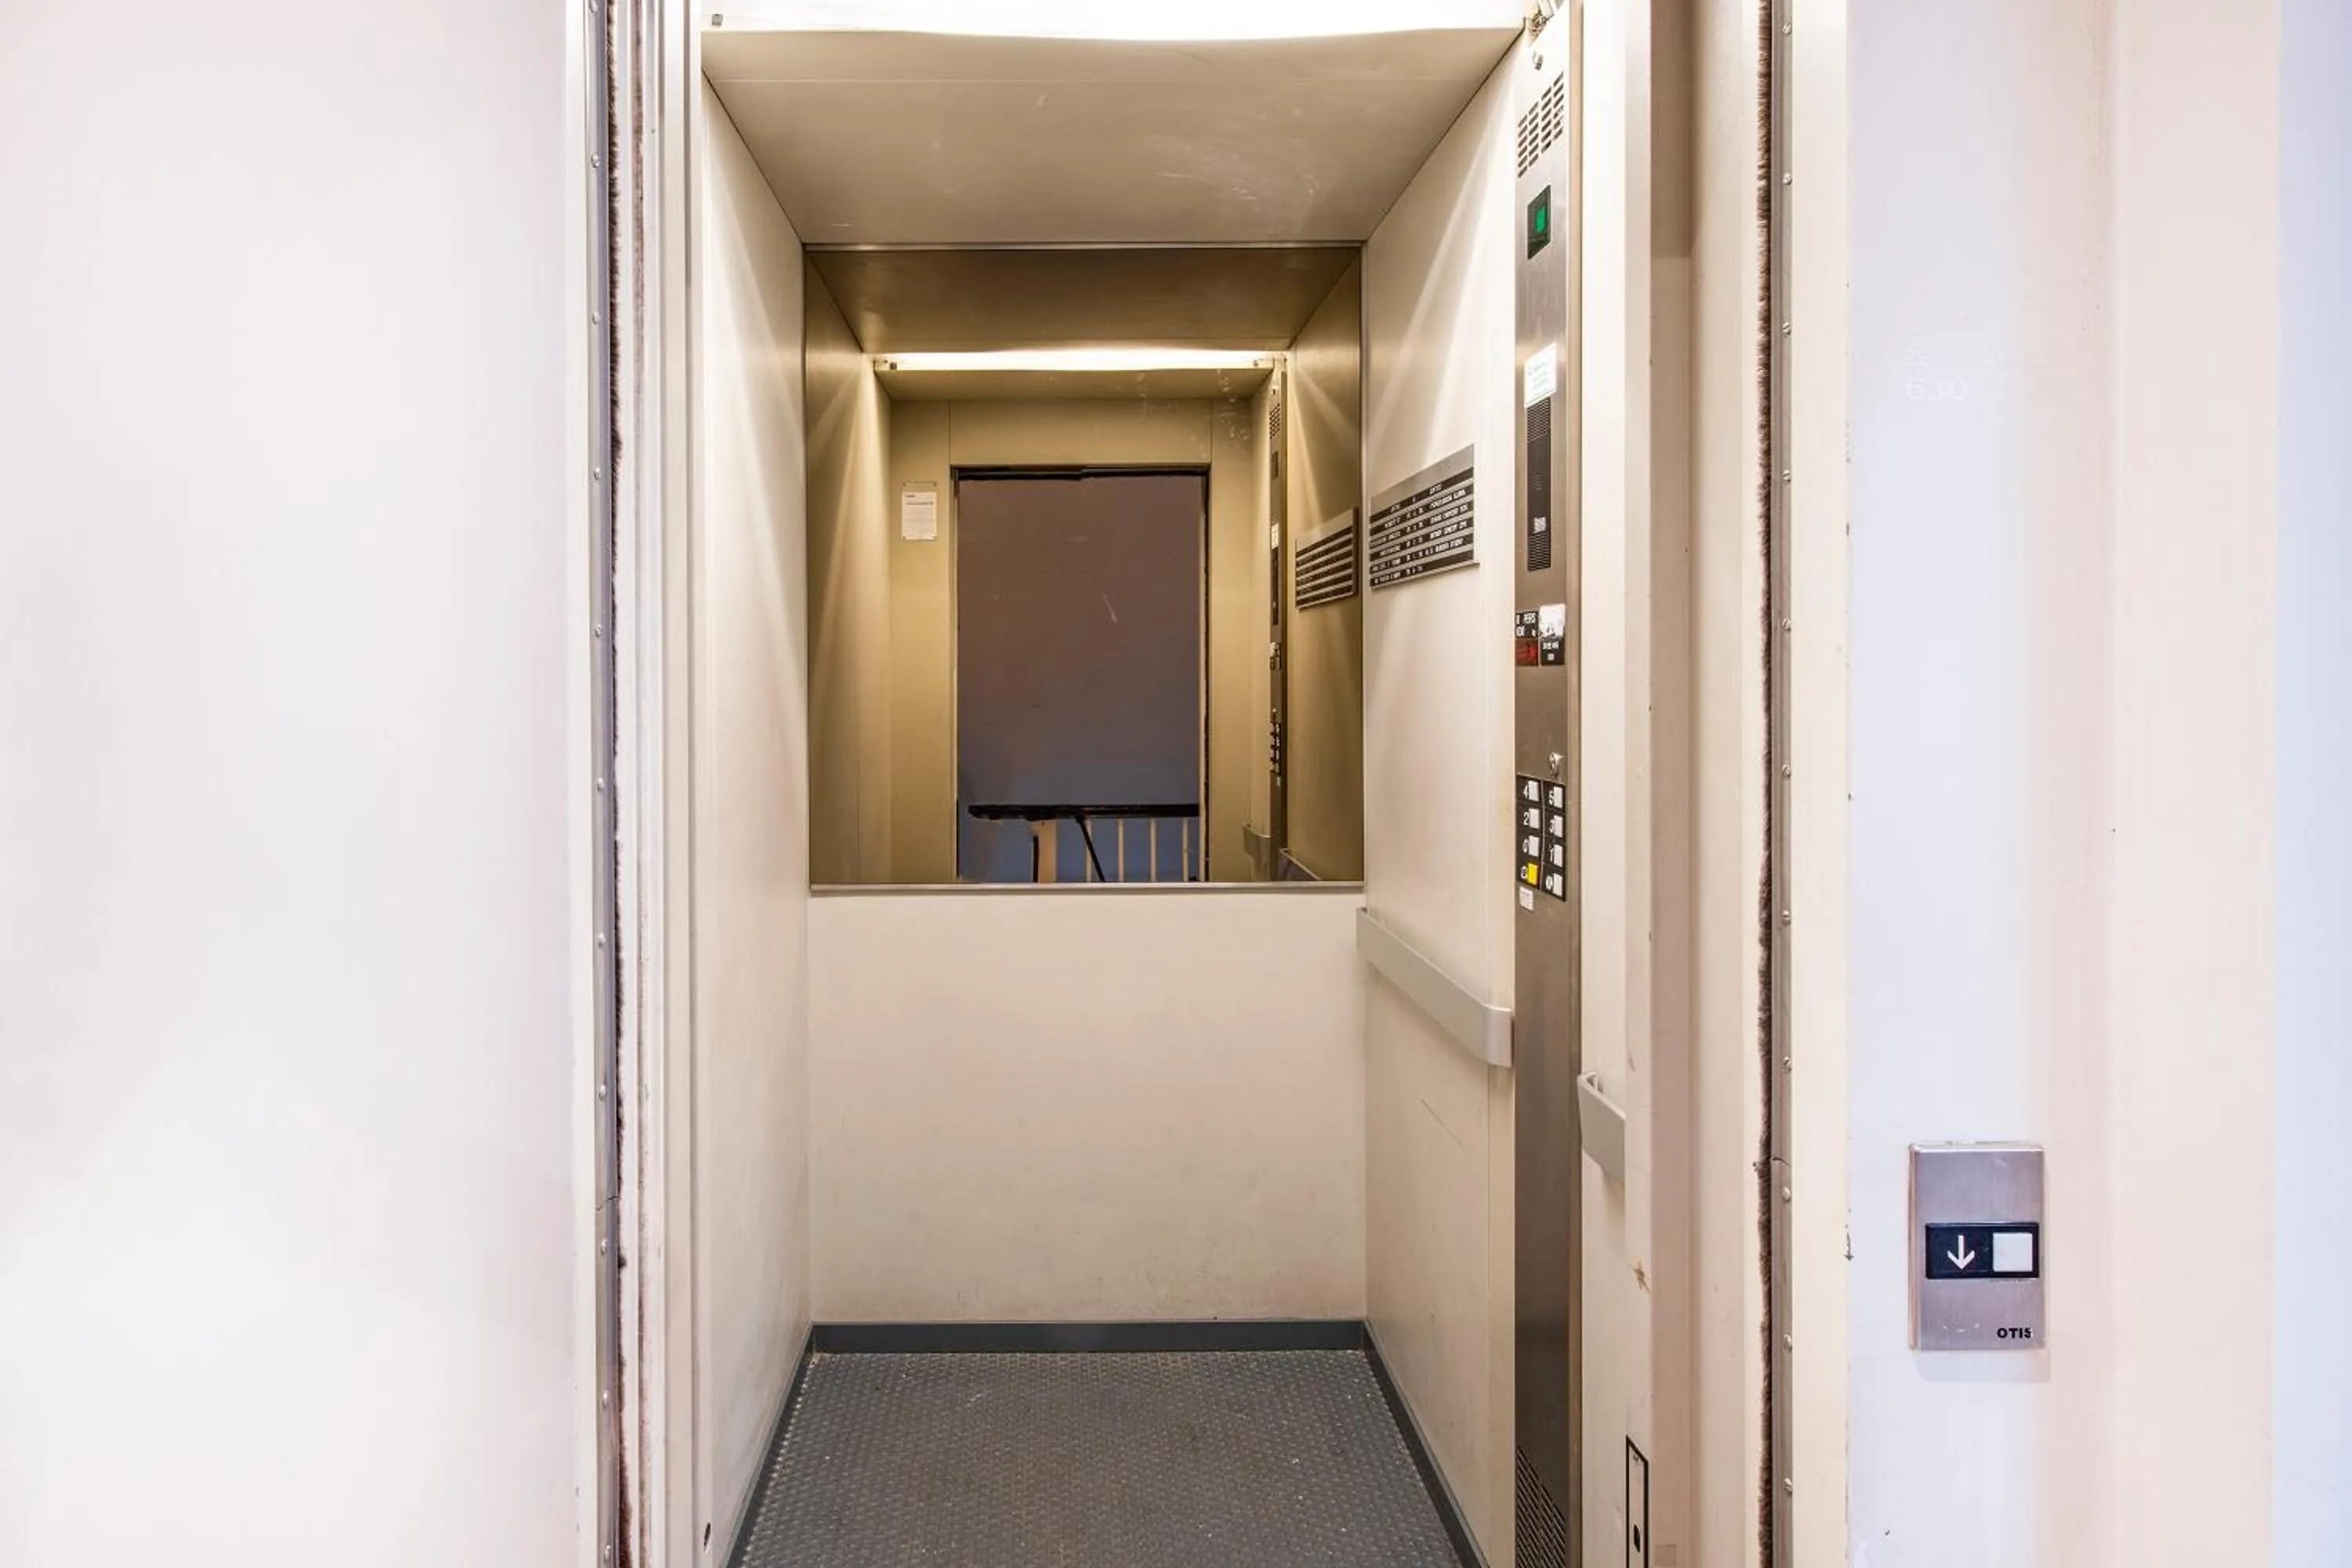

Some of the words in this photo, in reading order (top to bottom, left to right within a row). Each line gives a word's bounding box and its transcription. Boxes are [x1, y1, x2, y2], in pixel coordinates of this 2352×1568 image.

[1523, 785, 1528, 799] 4
[1523, 811, 1530, 826] 2
[1549, 819, 1555, 833] 3
[1997, 1327, 2031, 1339] OTIS
